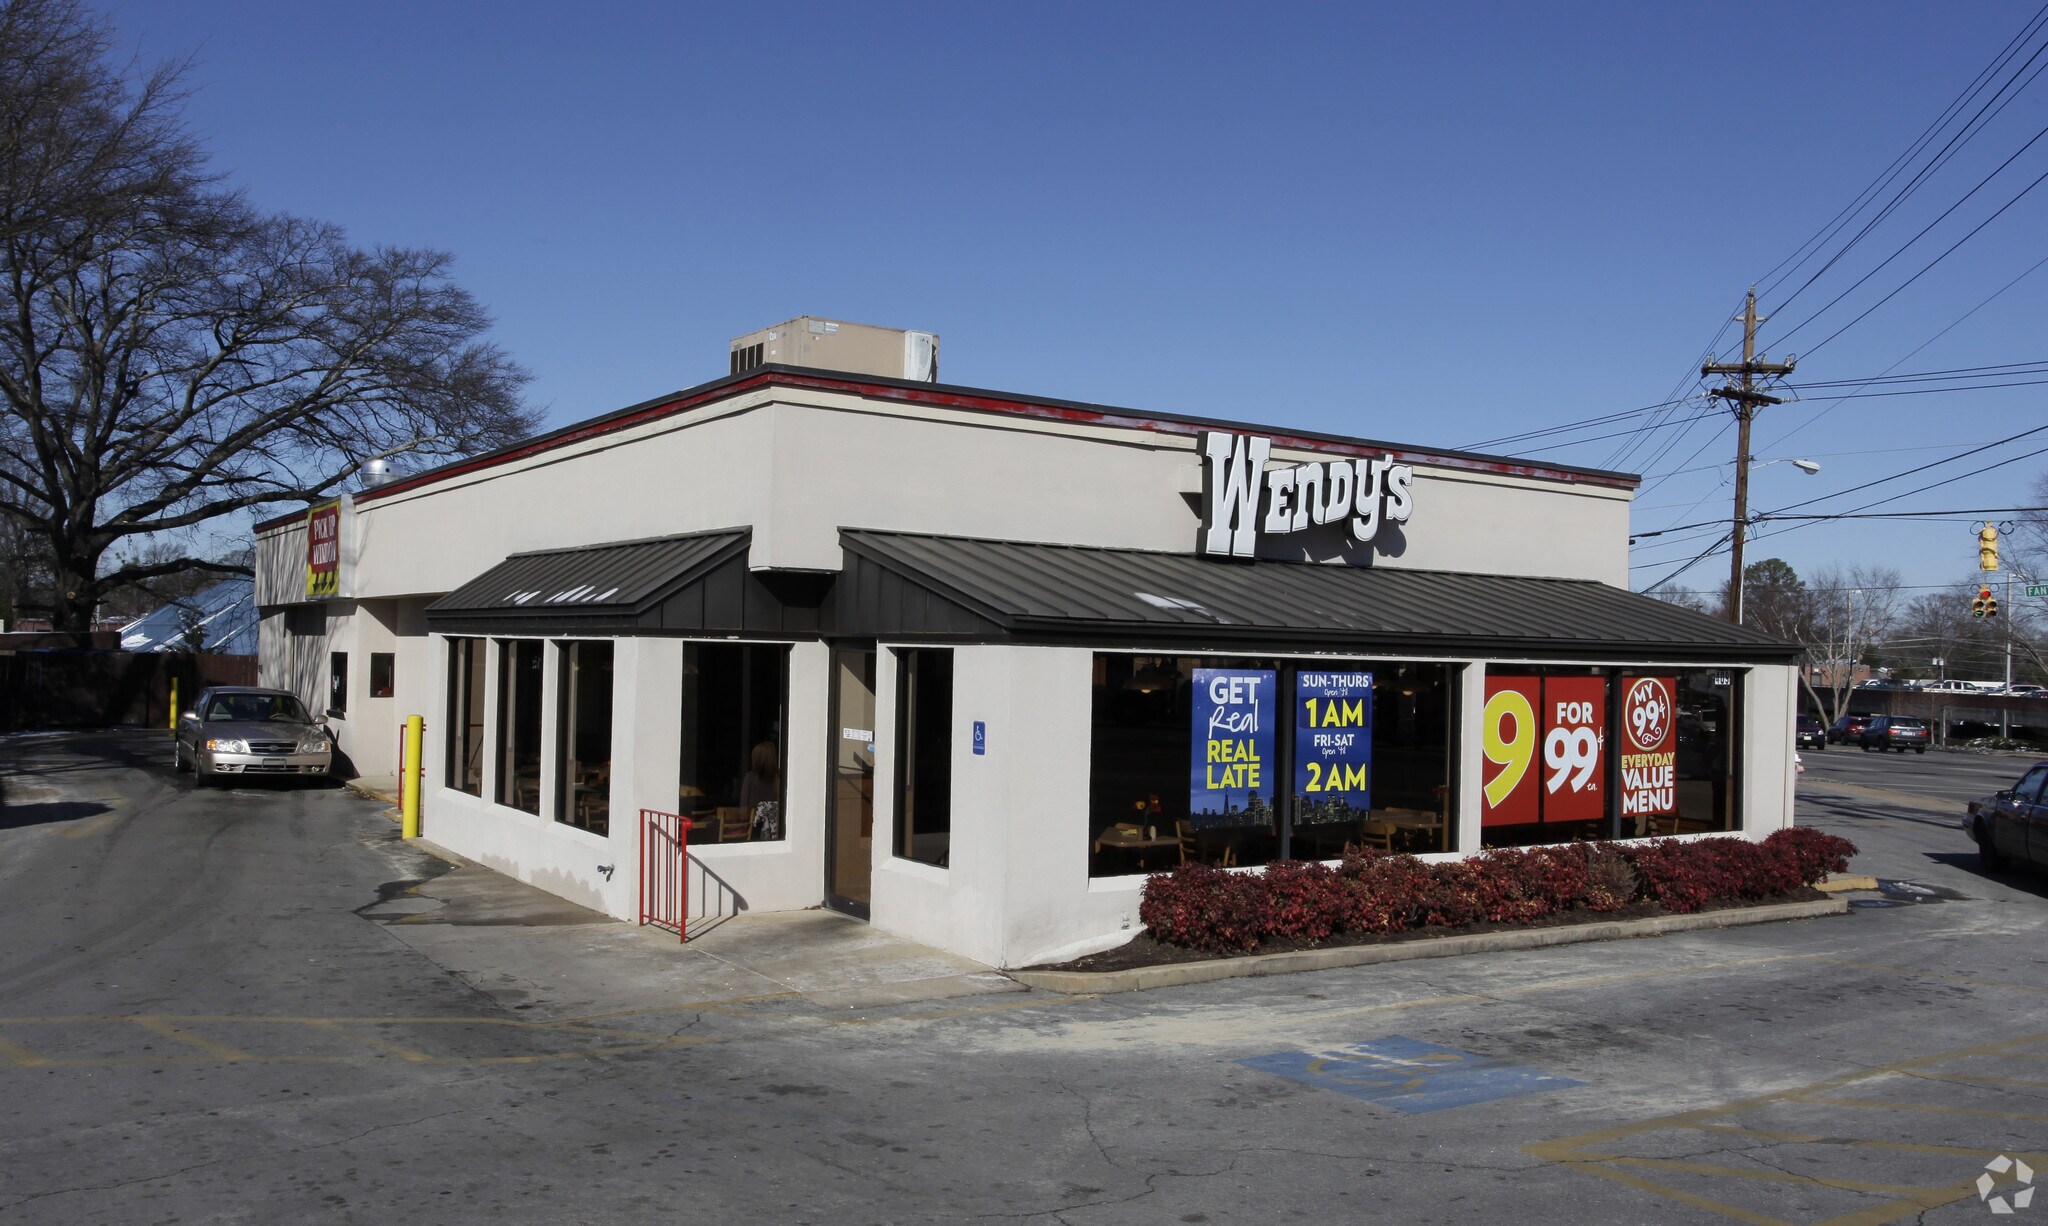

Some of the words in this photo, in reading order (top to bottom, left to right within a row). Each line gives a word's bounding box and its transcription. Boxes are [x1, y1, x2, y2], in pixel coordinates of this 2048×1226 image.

[2027, 586, 2048, 596] FAN
[1209, 676, 1261, 704] GET
[1302, 674, 1369, 688] SUN-THURS
[1634, 682, 1654, 706] MY
[1208, 699, 1259, 740] Real
[1305, 698, 1318, 728] 1
[1321, 699, 1364, 728] AM
[1556, 701, 1593, 724] FOR
[1207, 739, 1260, 763] REAL
[1314, 734, 1355, 747] FRI-SAT
[1482, 690, 1535, 809] 9
[1621, 752, 1676, 769] EVERYDAY
[1206, 763, 1260, 790] LATE
[1305, 762, 1321, 792] 2
[1324, 763, 1367, 792] AM
[1621, 766, 1674, 790] VALUE
[1622, 788, 1674, 814] MENU
